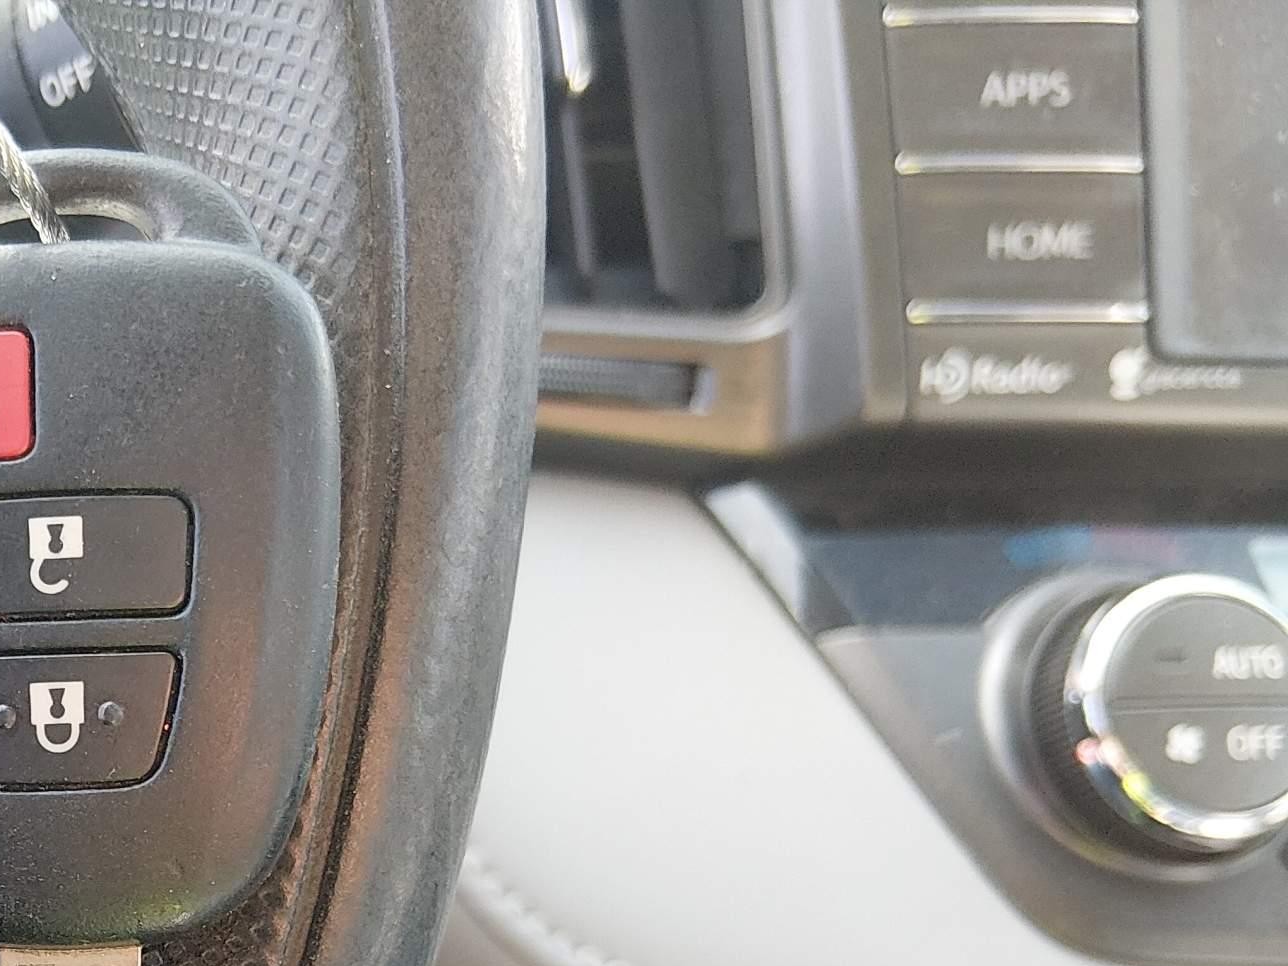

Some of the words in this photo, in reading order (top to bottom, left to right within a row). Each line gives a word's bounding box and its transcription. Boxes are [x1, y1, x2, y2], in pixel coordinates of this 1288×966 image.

[39, 53, 96, 107] OFF
[979, 70, 1071, 108] APPS
[986, 220, 1096, 260] HOME
[1212, 643, 1285, 680] AUTO
[1226, 722, 1286, 761] OFF
